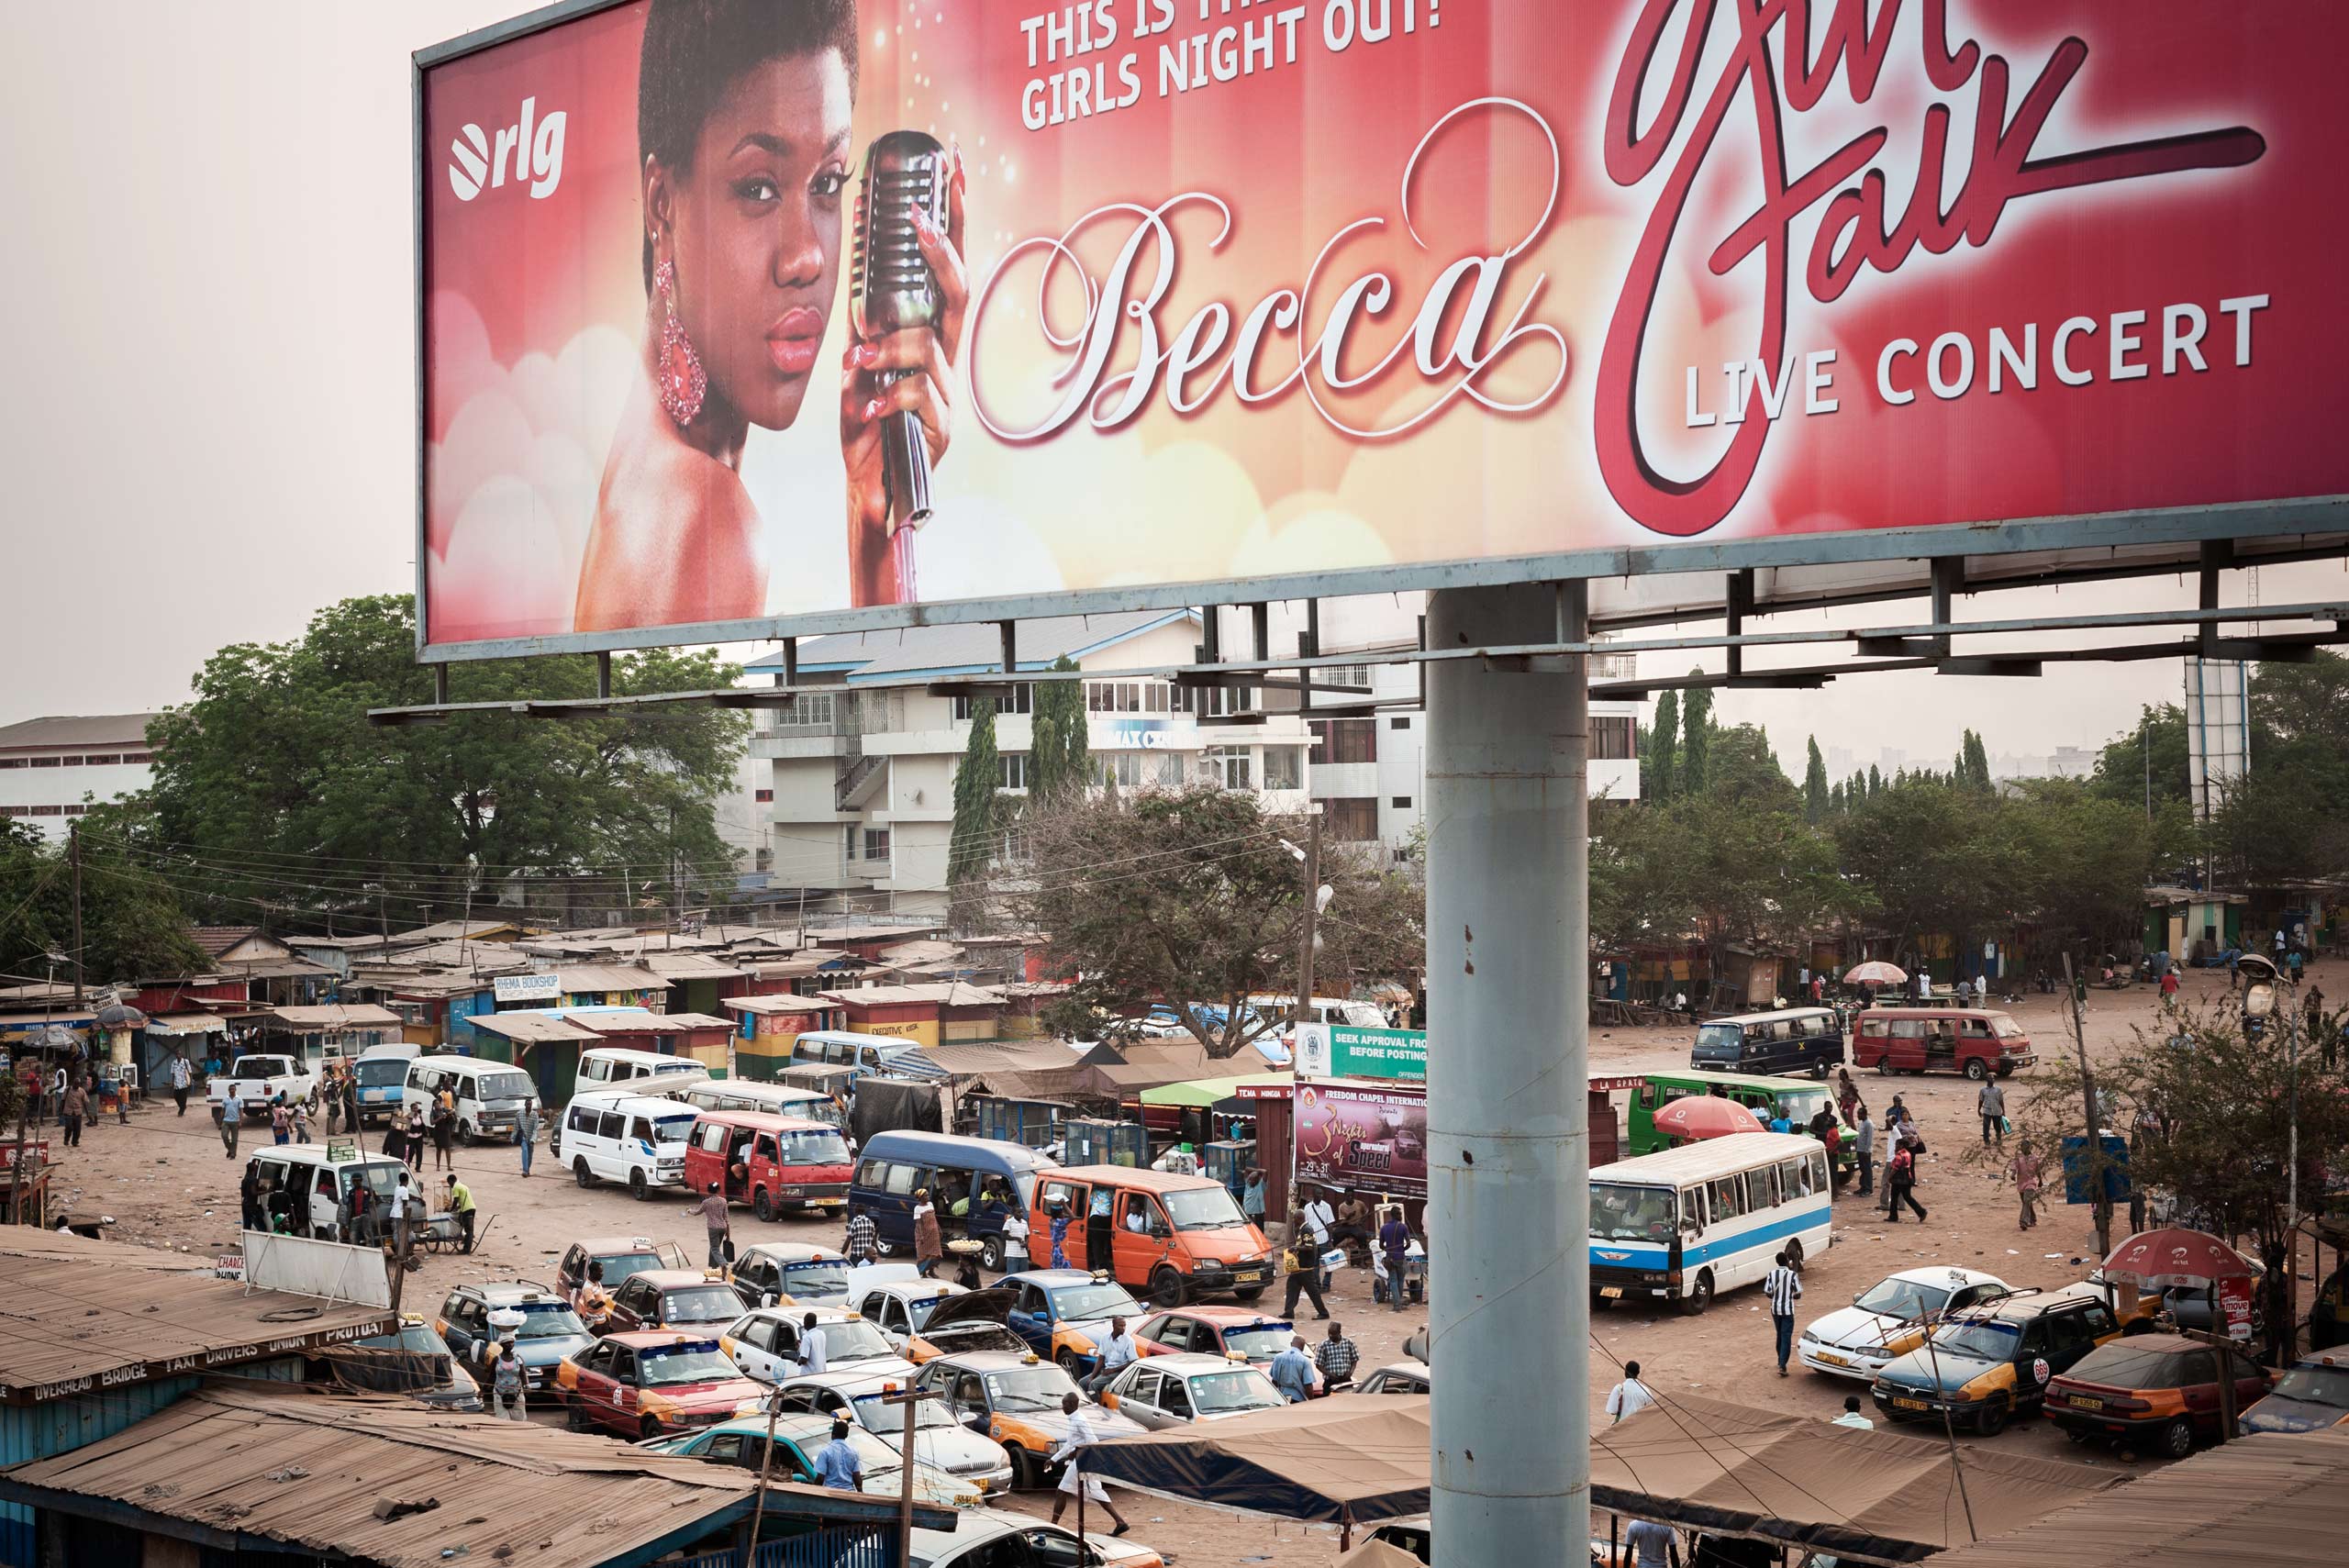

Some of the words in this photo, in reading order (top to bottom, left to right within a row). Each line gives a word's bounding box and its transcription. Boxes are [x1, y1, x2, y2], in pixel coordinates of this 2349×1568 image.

[1020, 0, 1119, 68] THIS
[1021, 52, 1141, 131] GIRLS
[1158, 5, 1307, 97] NIGHT
[492, 95, 567, 199] rlg
[974, 95, 1571, 442] Becca
[1686, 350, 1840, 428] LIVE
[1876, 294, 2271, 406] CONCERT
[495, 977, 521, 990] RHEMA
[521, 975, 558, 988] BOOKSHOP
[872, 1026, 903, 1035] EXECUTIVE
[1335, 1033, 1359, 1044] SEEK
[1361, 1035, 1408, 1048] APPROVAL
[1350, 1047, 1385, 1058] BEFORE
[1386, 1050, 1428, 1062] POSTING
[1599, 1081, 1609, 1090] LA
[1239, 1089, 1256, 1098] TEMA
[1325, 1090, 1357, 1102] FREEDOM
[1359, 1092, 1386, 1104] CHAPEL
[1332, 1118, 1368, 1143] Nights
[1332, 1144, 1344, 1167] of
[1349, 1140, 1392, 1171] Speed
[1307, 1161, 1314, 1172] 29
[218, 1256, 244, 1269] CHARGE
[2225, 1302, 2248, 1311] move
[35, 1376, 93, 1400] OVERHEAD
[102, 1363, 147, 1386] BRIDGE
[166, 1355, 195, 1373] TAXI
[206, 1343, 258, 1364] DRIVERS
[269, 1335, 306, 1352] UNION
[2034, 1363, 2048, 1376] 669
